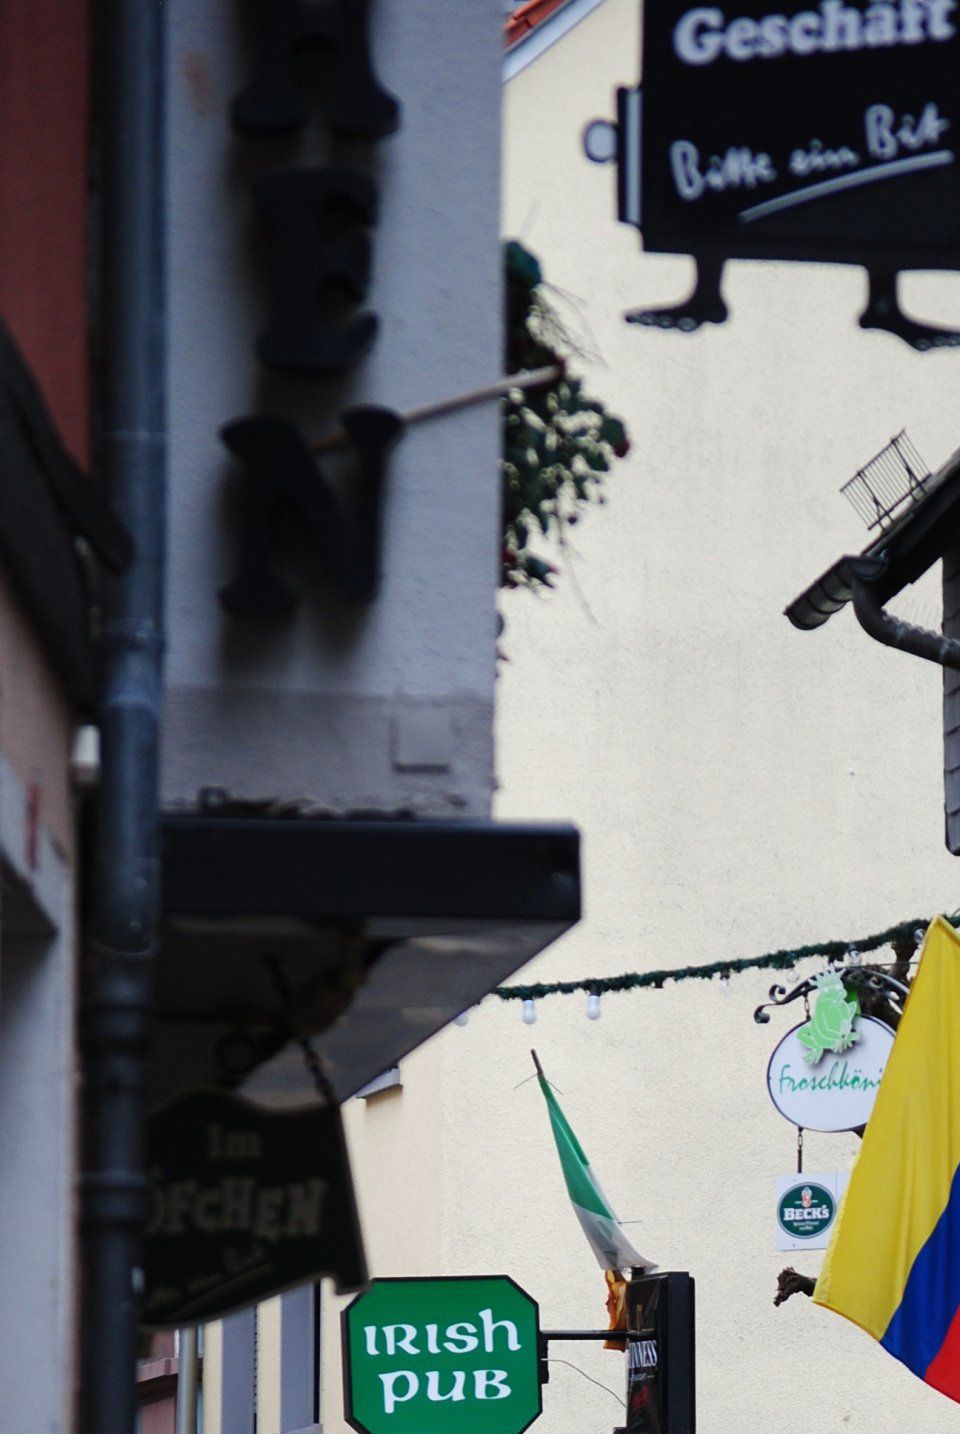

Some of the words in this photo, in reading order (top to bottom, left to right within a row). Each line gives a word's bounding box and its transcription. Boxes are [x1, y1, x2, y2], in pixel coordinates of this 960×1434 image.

[670, 139, 777, 200] Bitte
[788, 138, 860, 176] ein
[865, 101, 949, 159] Bit
[779, 1061, 884, 1094] Froschköni
[783, 1204, 830, 1221] BECK'S
